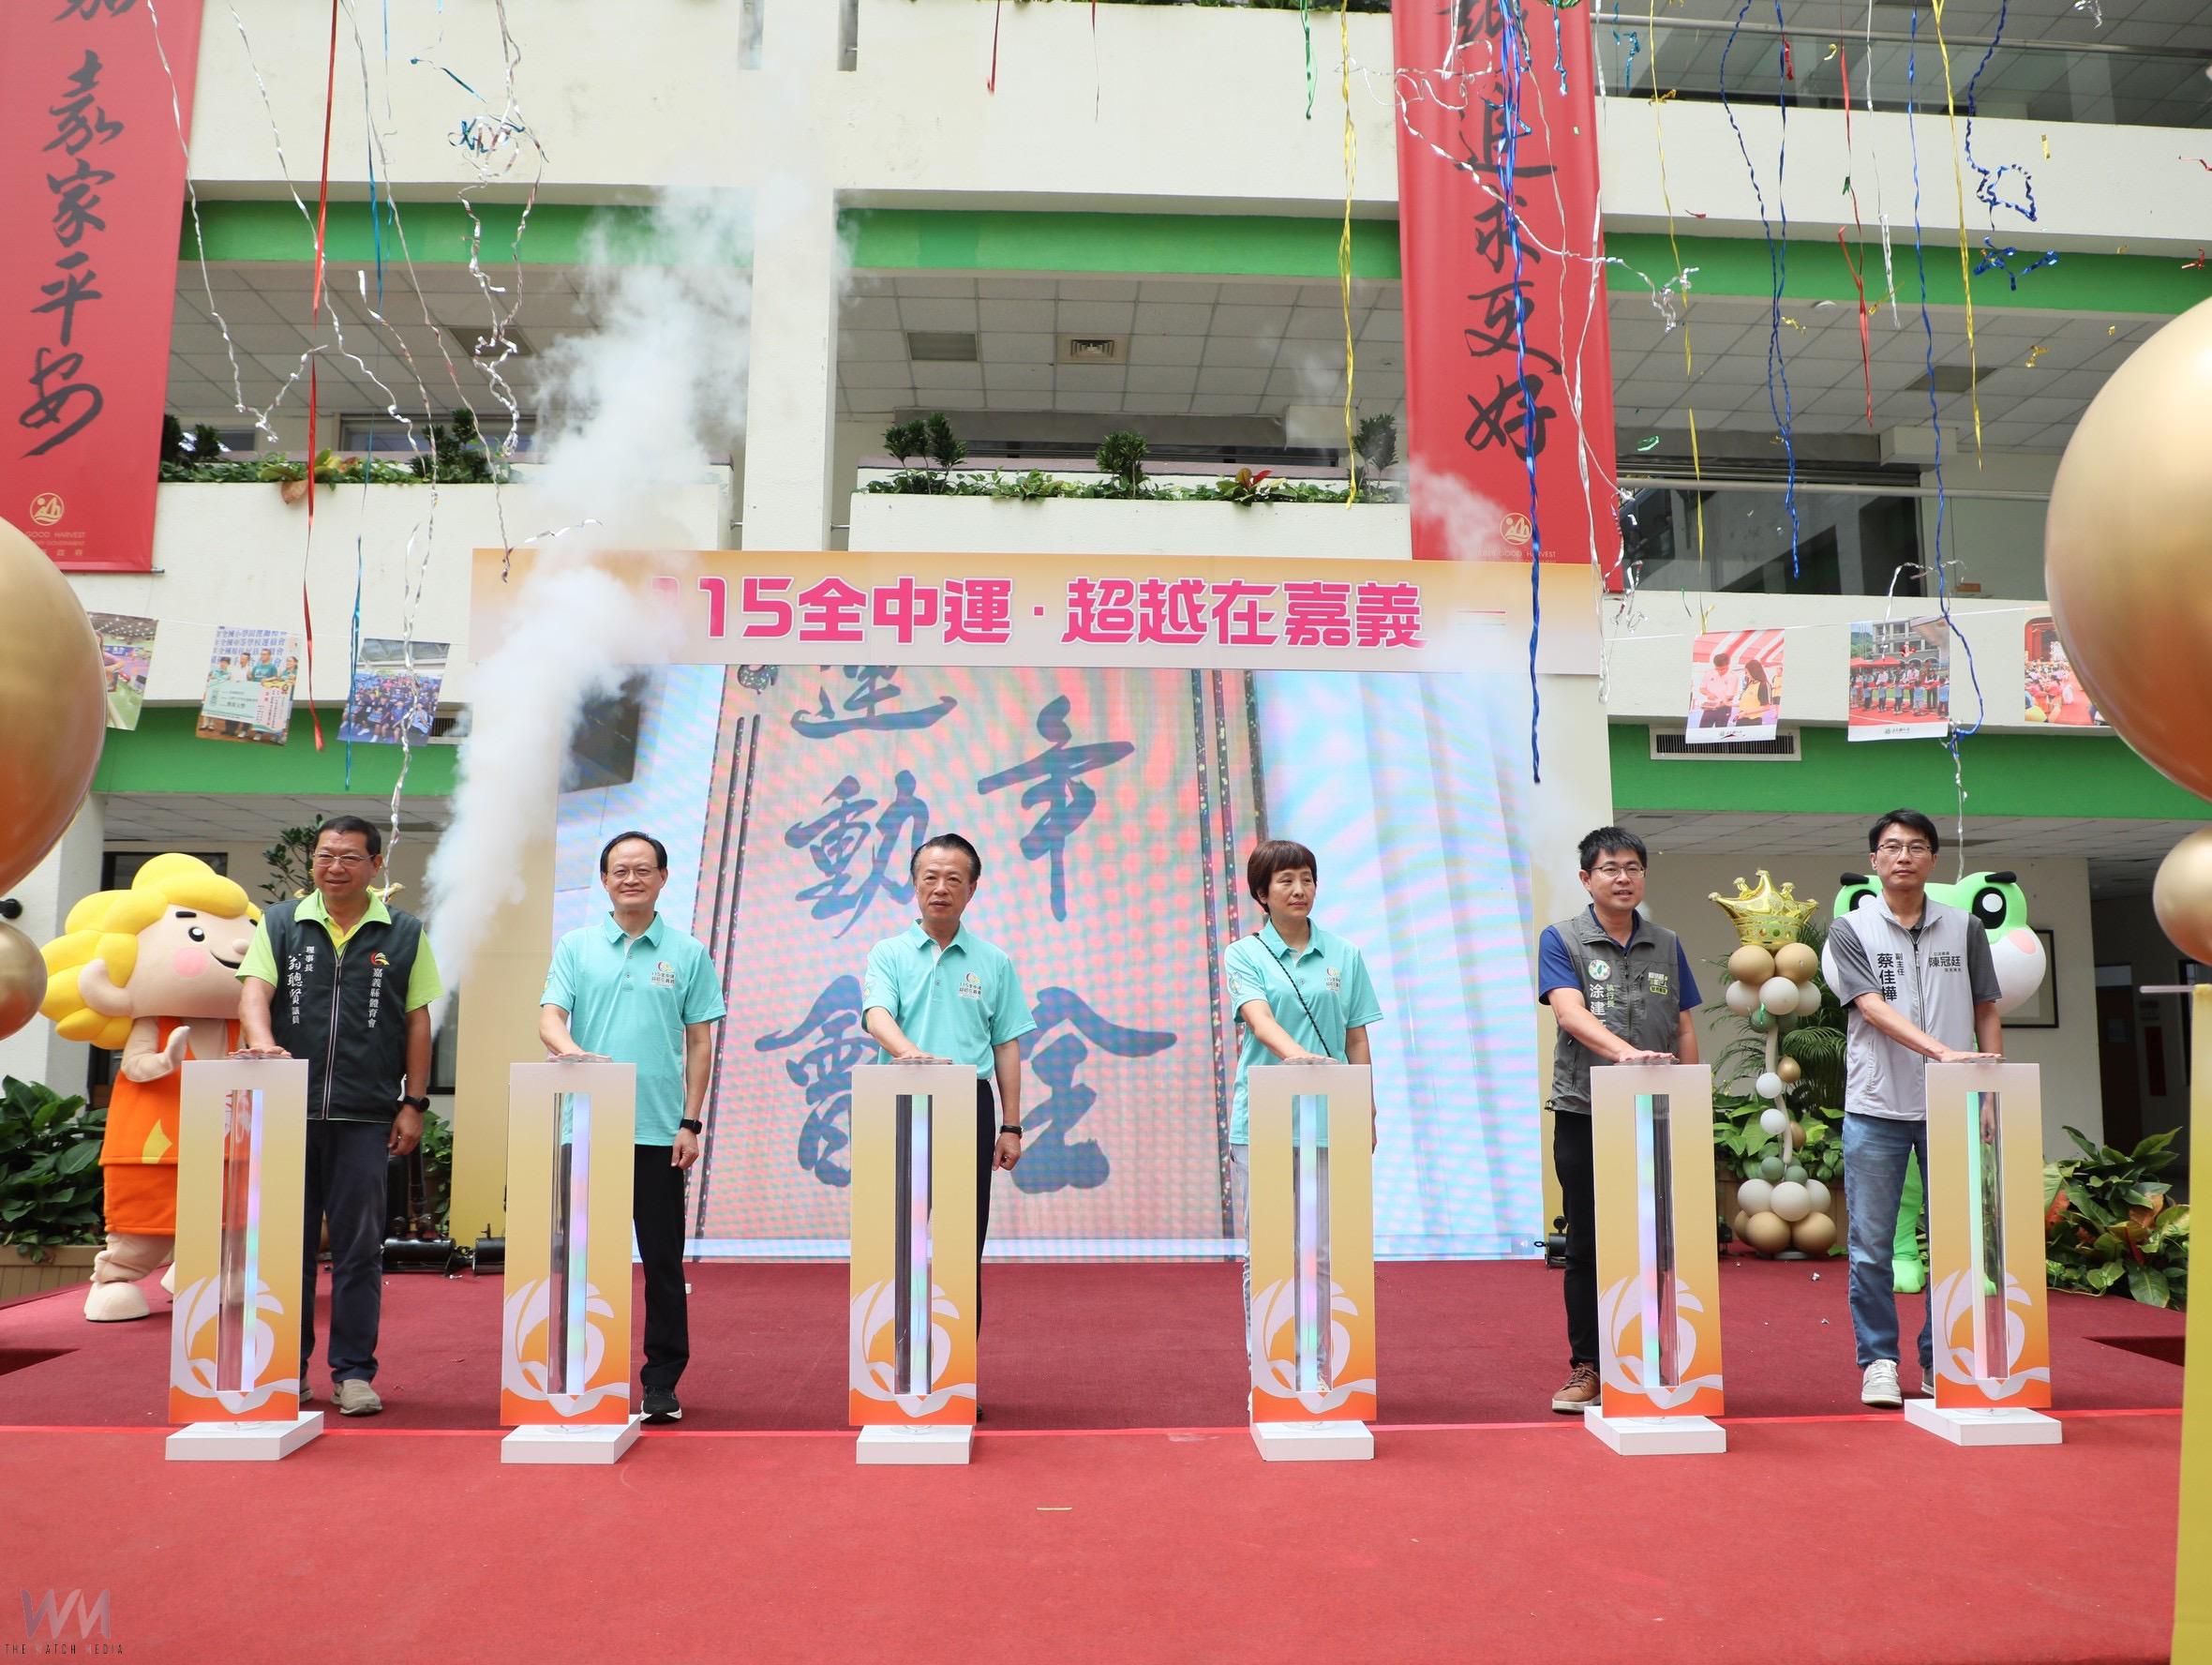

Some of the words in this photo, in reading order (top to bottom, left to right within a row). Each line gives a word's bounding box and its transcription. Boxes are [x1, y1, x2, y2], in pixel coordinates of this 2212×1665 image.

[19, 0, 136, 460] 嘉家平安
[304, 946, 315, 972] 理事長
[1895, 952, 1905, 976] 副主任
[1928, 955, 1961, 968] 陳冠廷
[367, 968, 383, 1028] 嘉義縣體育會
